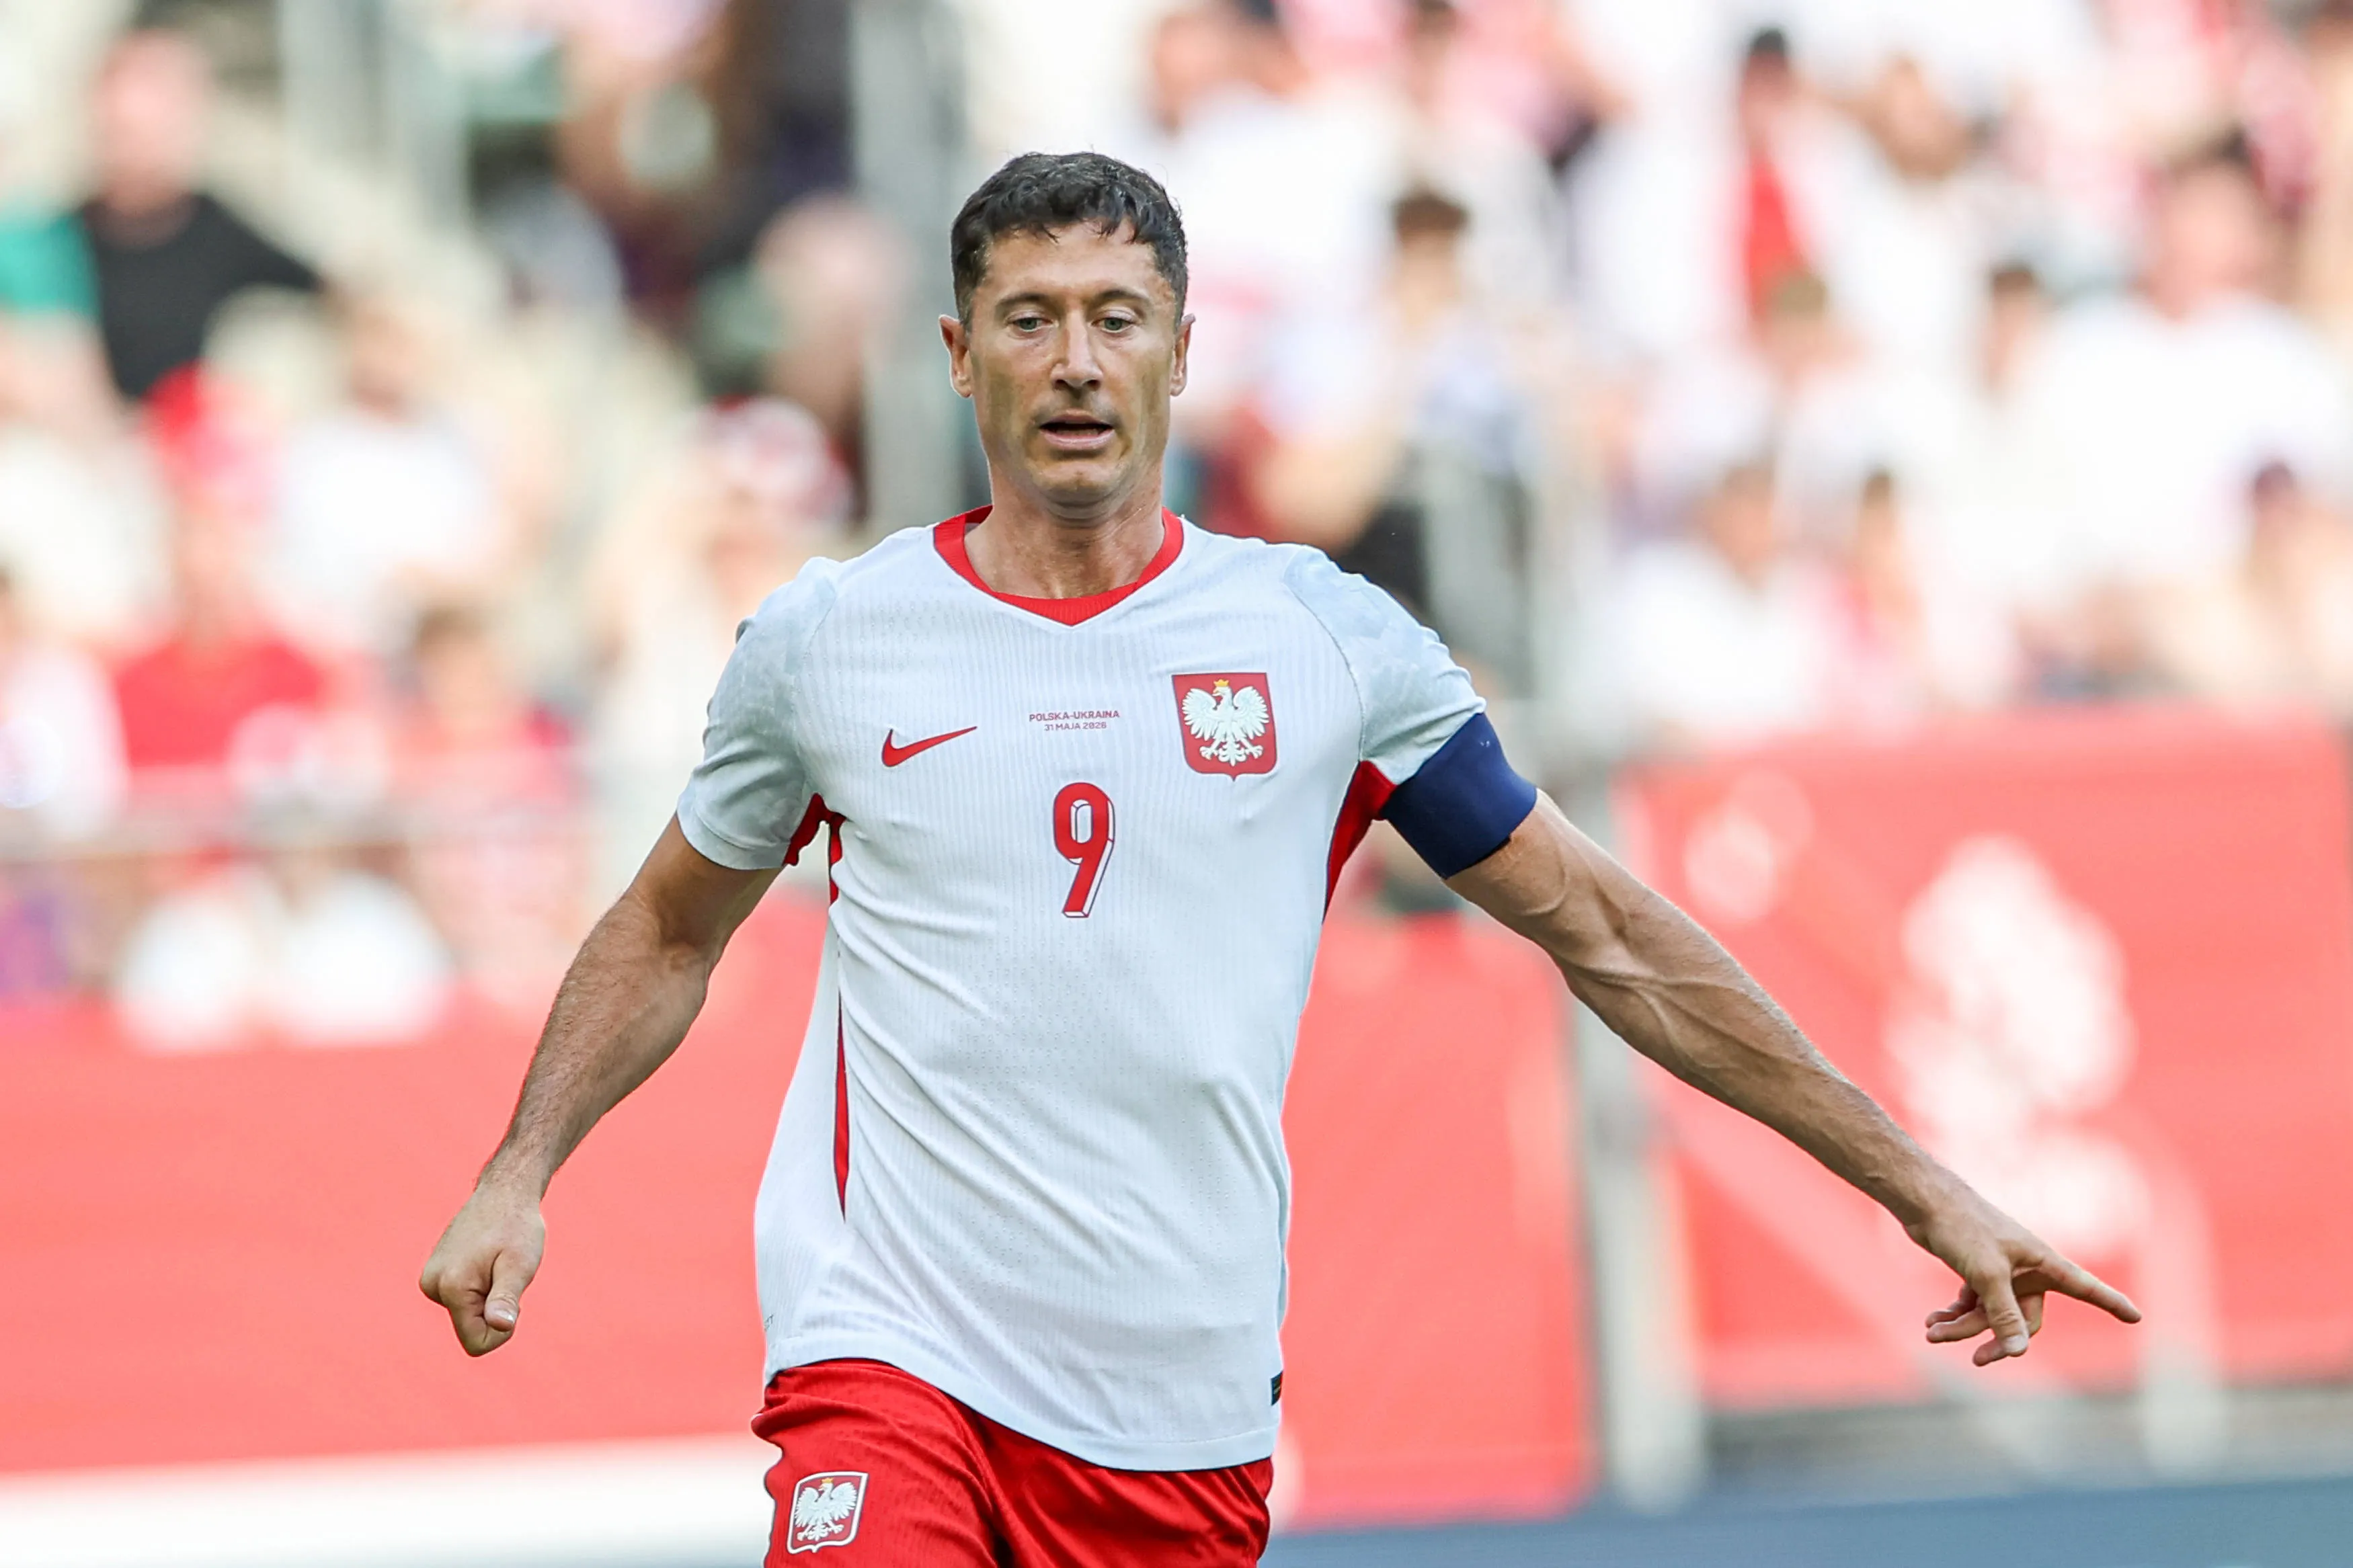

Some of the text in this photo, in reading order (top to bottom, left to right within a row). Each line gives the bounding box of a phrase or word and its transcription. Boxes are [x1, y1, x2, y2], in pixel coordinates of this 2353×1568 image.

[1029, 710, 1120, 722] POLSKA-UKRAINA
[1044, 723, 1054, 731] 31
[1055, 723, 1081, 731] MAJA
[1053, 782, 1116, 918] 9
